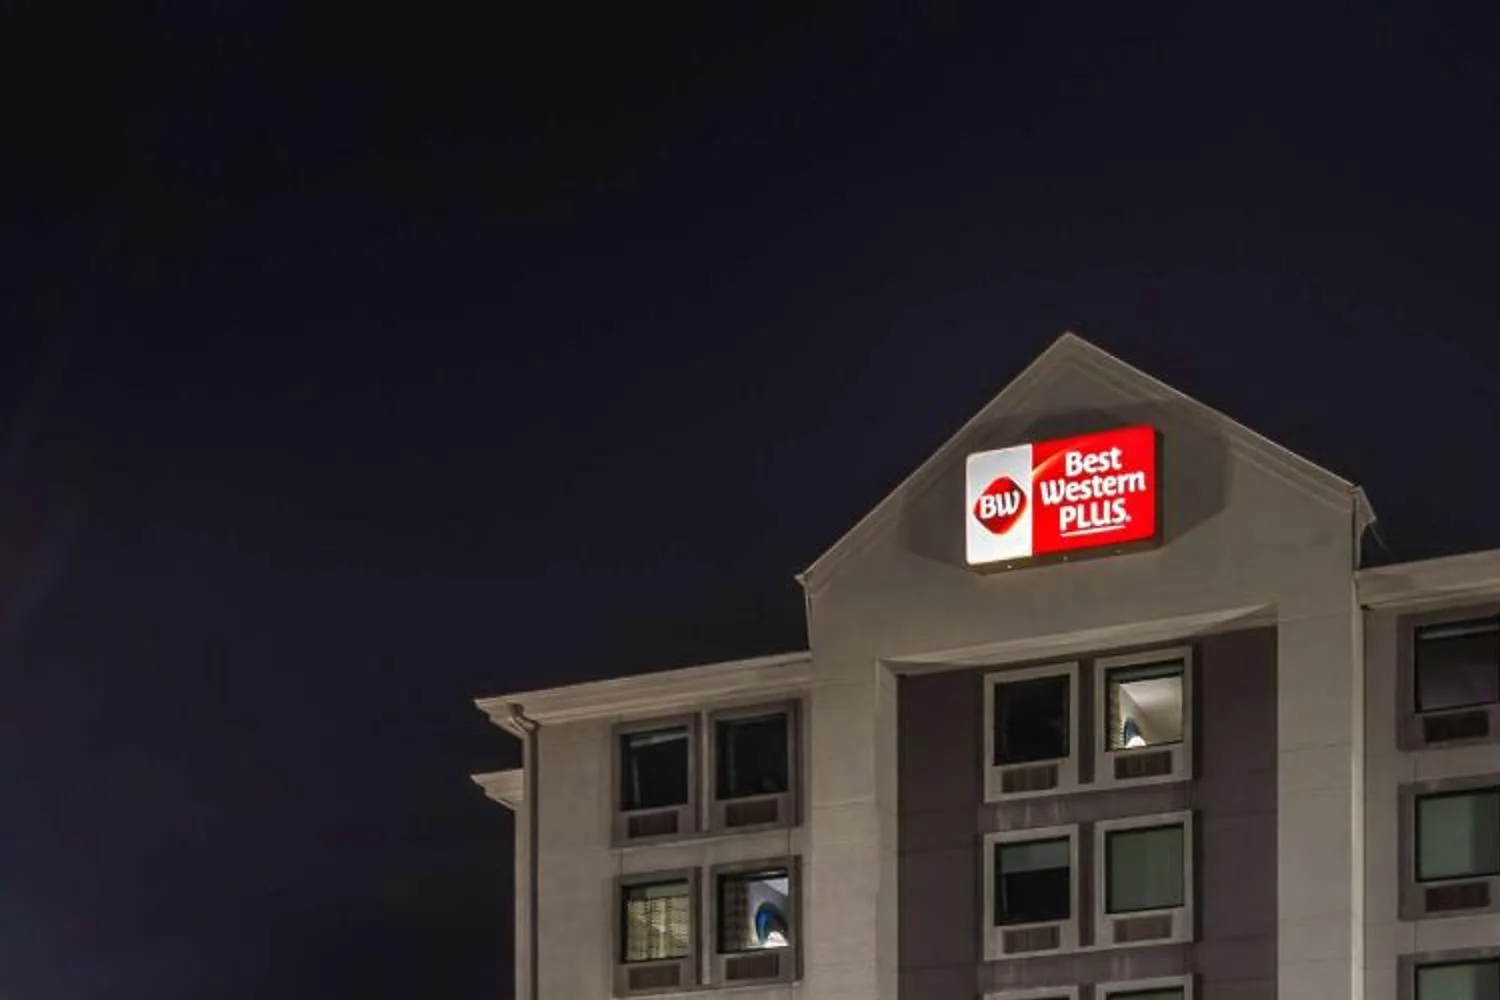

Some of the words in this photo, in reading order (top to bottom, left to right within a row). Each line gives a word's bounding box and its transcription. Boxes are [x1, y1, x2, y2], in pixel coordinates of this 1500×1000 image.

[1065, 447, 1123, 478] Best
[1040, 471, 1147, 506] Western
[978, 491, 1021, 519] BW
